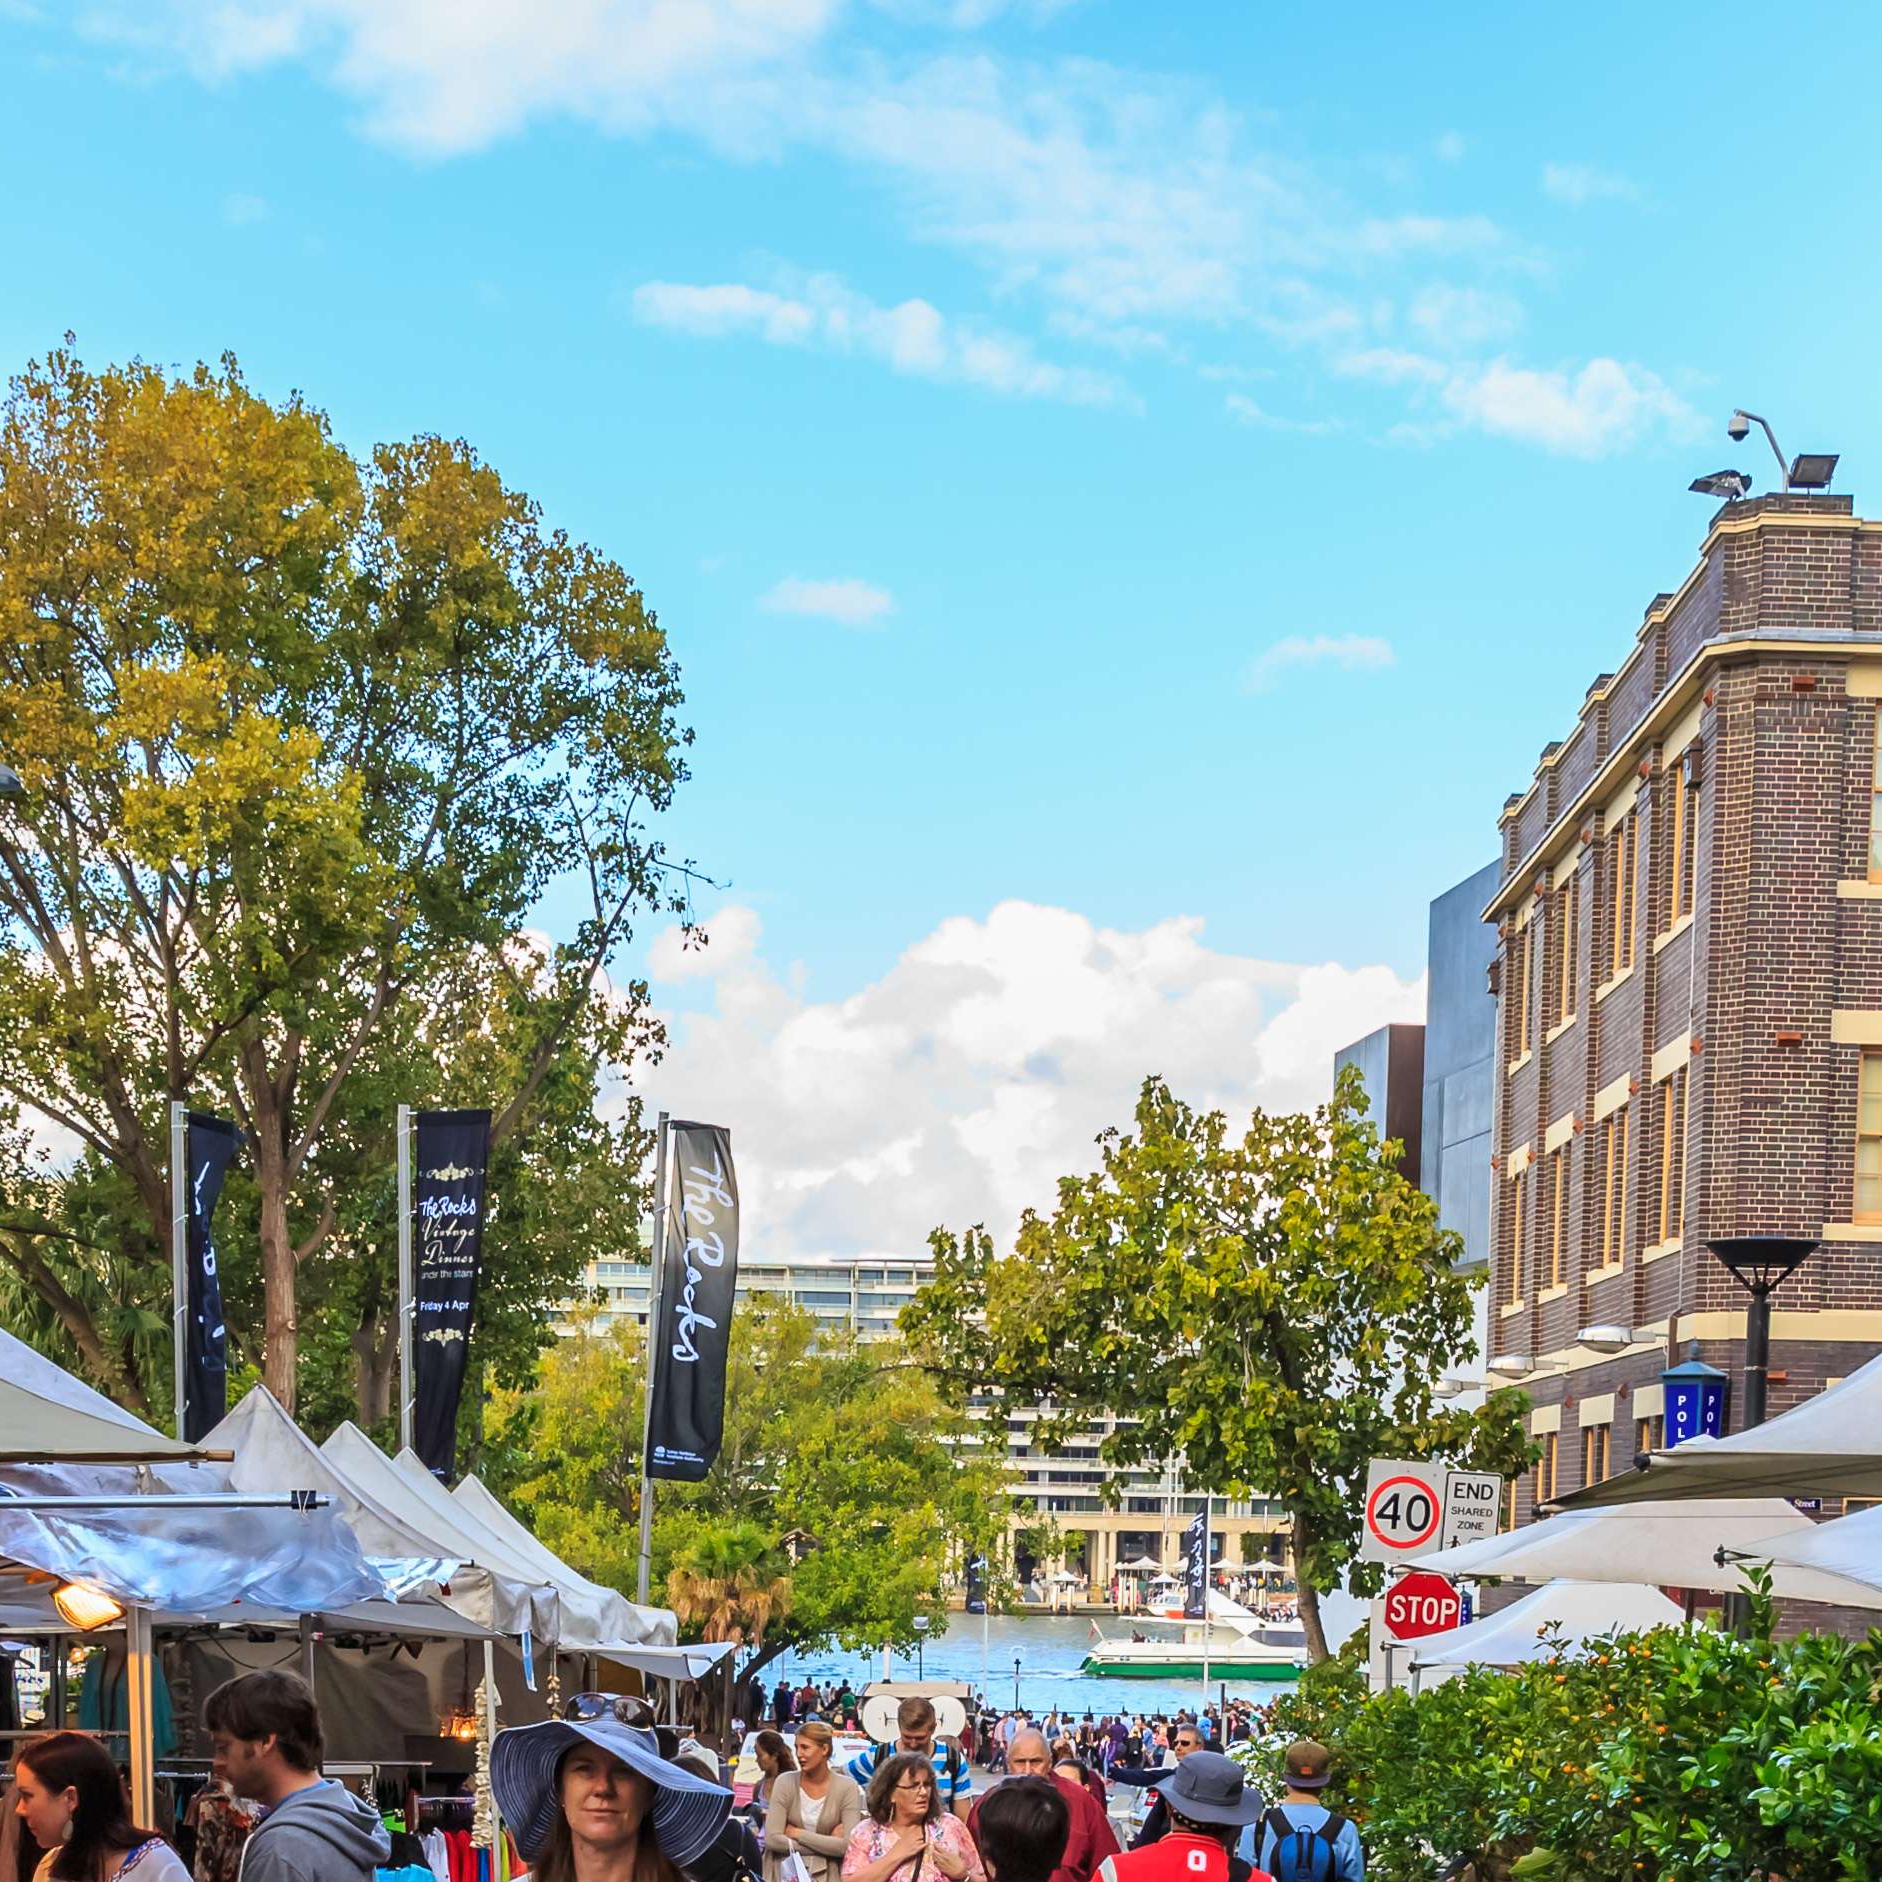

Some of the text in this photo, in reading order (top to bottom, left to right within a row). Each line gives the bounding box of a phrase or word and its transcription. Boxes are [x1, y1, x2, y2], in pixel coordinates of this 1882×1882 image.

[419, 1194, 477, 1219] The Rocks
[420, 1240, 475, 1266] Dinner
[671, 1149, 734, 1362] The Rocks
[444, 1301, 450, 1310] 4
[451, 1299, 470, 1312] Apr
[1676, 1395, 1688, 1439] POL
[1453, 1482, 1494, 1501] END
[1376, 1492, 1431, 1532] 40
[1450, 1506, 1493, 1518] SHARED
[1457, 1520, 1485, 1531] ZONE
[1390, 1594, 1457, 1626] STOP
